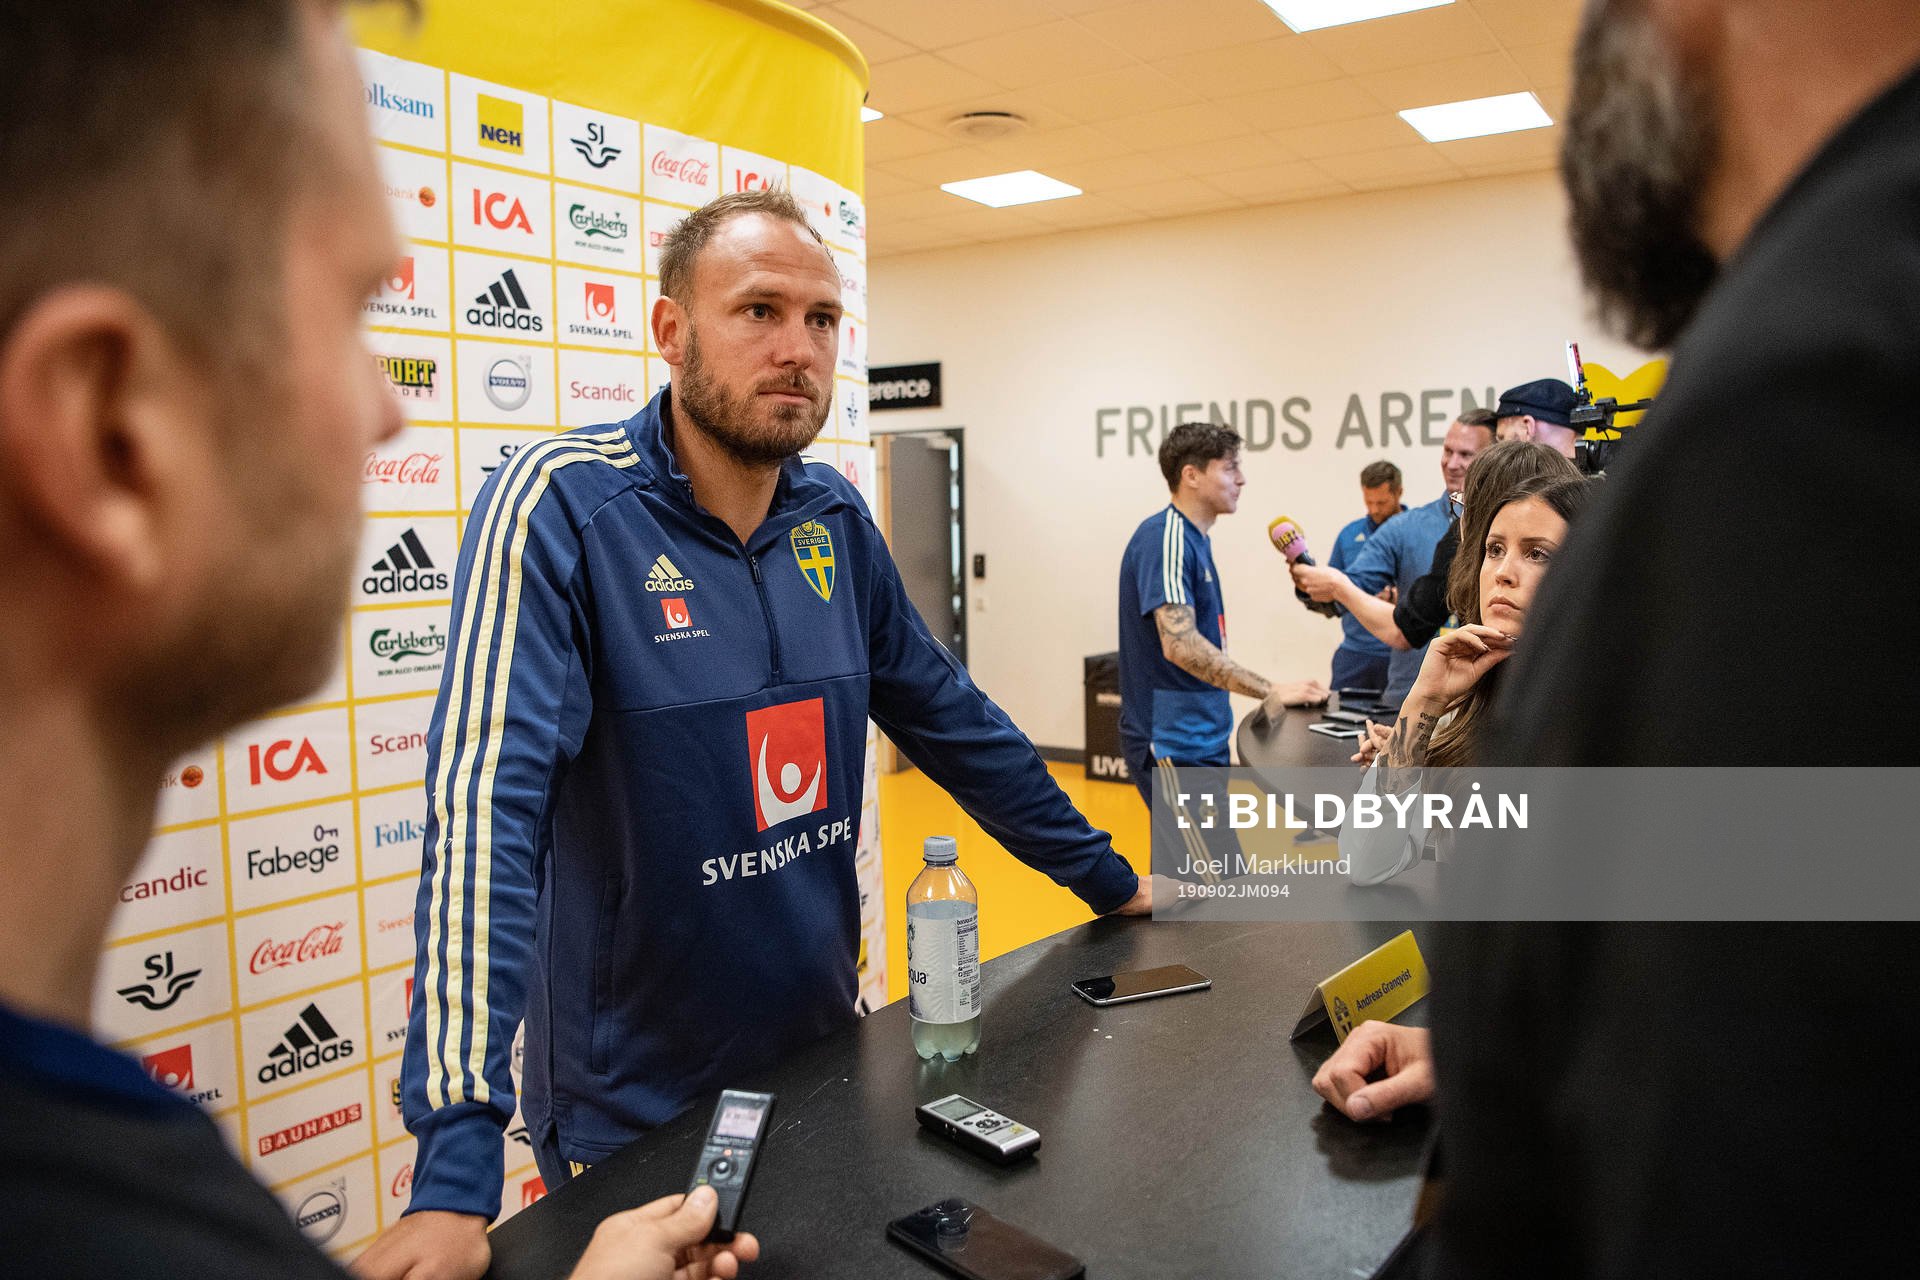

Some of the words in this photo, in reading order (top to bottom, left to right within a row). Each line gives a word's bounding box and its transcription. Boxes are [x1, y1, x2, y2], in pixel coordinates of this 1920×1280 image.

[363, 82, 434, 119] olksam
[587, 122, 605, 145] SJ
[473, 189, 534, 235] ICA
[569, 203, 628, 239] Carlsberg
[360, 302, 407, 315] VENSKA
[411, 306, 437, 319] SPEL
[466, 306, 543, 333] adidas
[569, 324, 610, 338] SVENSKA
[612, 327, 633, 340] SPEL
[375, 355, 437, 388] PORT
[491, 376, 525, 388] VOLVO
[570, 381, 636, 403] Scandic
[868, 378, 931, 401] erence
[1335, 386, 1496, 449] ARE
[500, 444, 518, 458] S
[797, 535, 827, 546] SVERIGE
[362, 569, 449, 595] adidas
[644, 578, 695, 592] adidas
[369, 624, 446, 660] Carlsberg
[654, 630, 692, 643] SVENSKA
[692, 629, 711, 639] SPEL
[370, 733, 428, 756] Scan
[248, 736, 329, 786] ICA
[375, 819, 426, 848] Folks
[247, 844, 339, 880] Fabege
[702, 832, 811, 886] SVENSKA
[817, 816, 852, 850] SPE
[119, 866, 208, 904] candic
[378, 912, 414, 933] Swed
[249, 921, 346, 975] Coca-Cola
[144, 951, 173, 980] SJ
[1356, 988, 1383, 1011] Andreas
[1382, 969, 1412, 994] Granqvist
[258, 1039, 354, 1084] adidas
[190, 1088, 223, 1104] SPEL
[259, 1103, 362, 1156] BAUHAUS
